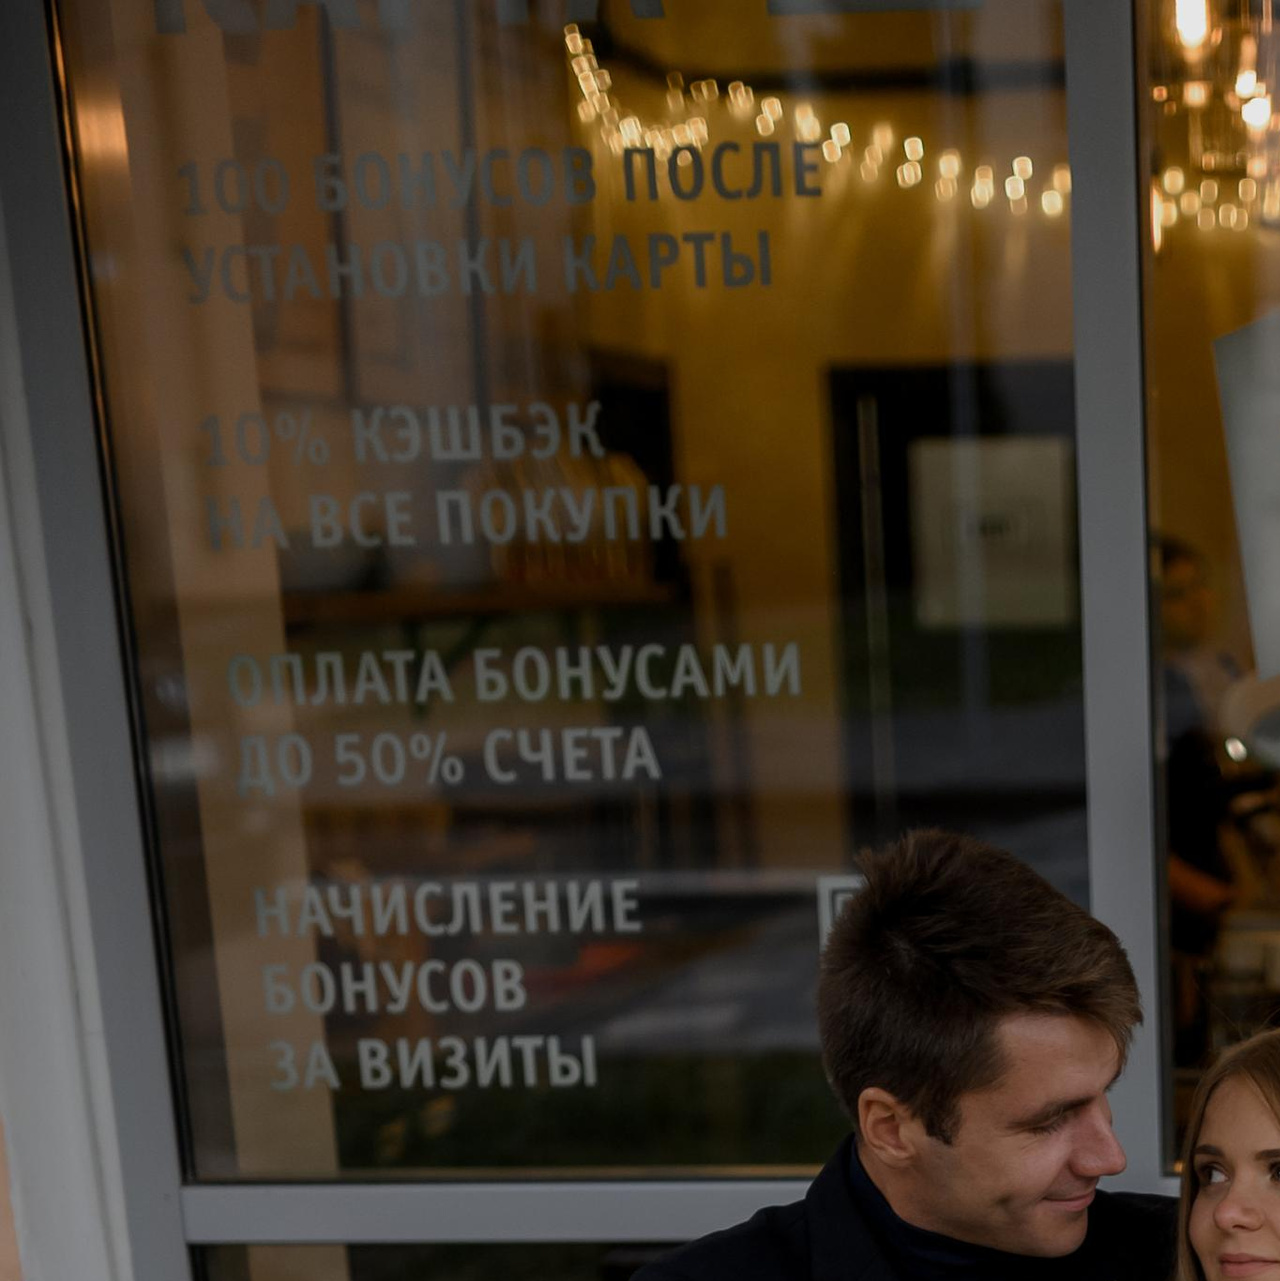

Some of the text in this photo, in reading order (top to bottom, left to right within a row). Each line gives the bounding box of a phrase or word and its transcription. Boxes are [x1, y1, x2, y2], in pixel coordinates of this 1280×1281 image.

[312, 146, 597, 214] БОНУСОВ
[625, 139, 824, 202] ПОСЛЕ
[179, 229, 772, 305] УСТАНОВКИ КАРТЫ
[352, 400, 605, 463] КЭШБЭК
[206, 485, 728, 550] НА ВСЕ ПОКУПКИ
[227, 642, 803, 707] ОПЛАТА БОНУСАМИ
[238, 726, 662, 797] ДО 50% СЧЕТА
[255, 879, 645, 936] НАЧИСЛЕНИЕ
[261, 959, 527, 1015] БОНУСОВ
[269, 1034, 598, 1090] ЗА ВИЗИТЫ
